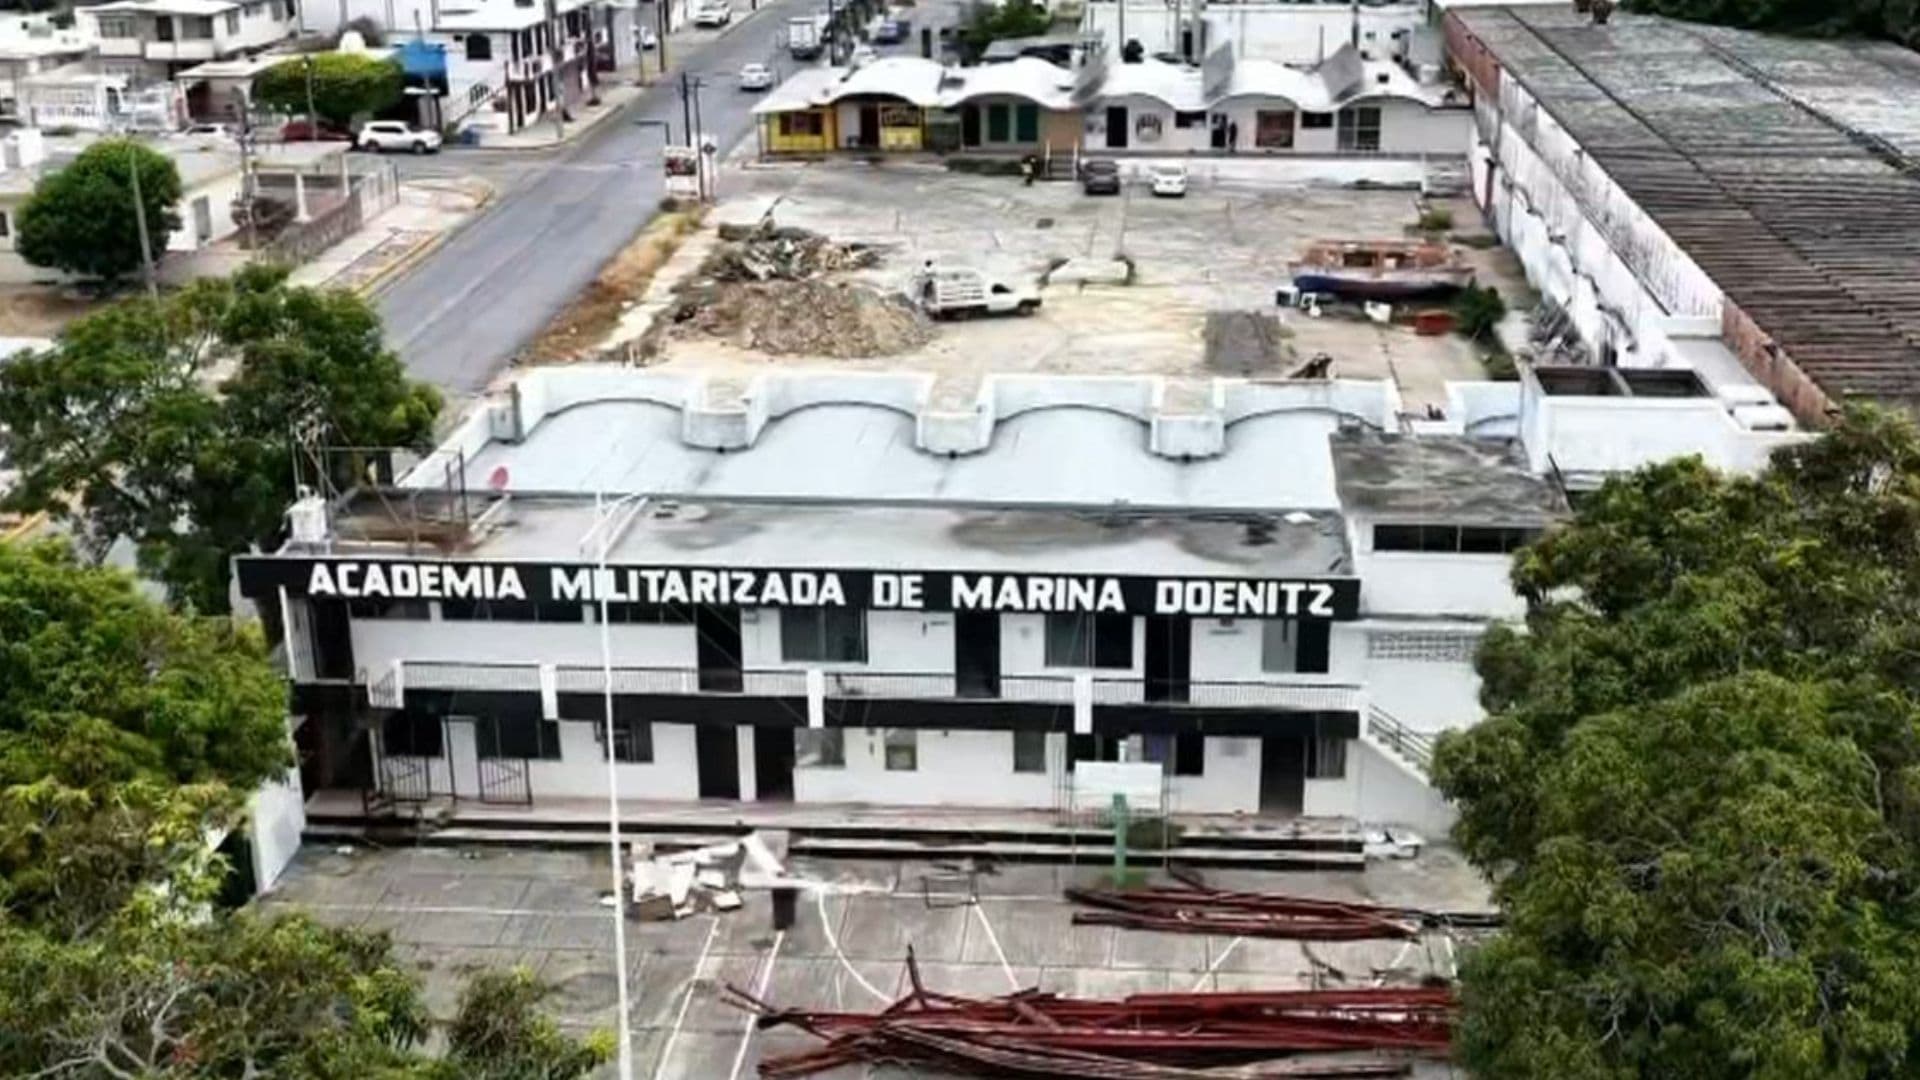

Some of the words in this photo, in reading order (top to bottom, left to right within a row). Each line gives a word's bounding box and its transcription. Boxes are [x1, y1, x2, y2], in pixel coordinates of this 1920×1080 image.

[308, 562, 526, 600] ACADEMIA
[550, 567, 846, 606] MILITARIZADA
[872, 573, 924, 609] DE
[951, 575, 1126, 612] MARINA
[1155, 580, 1334, 616] DOENITZ
